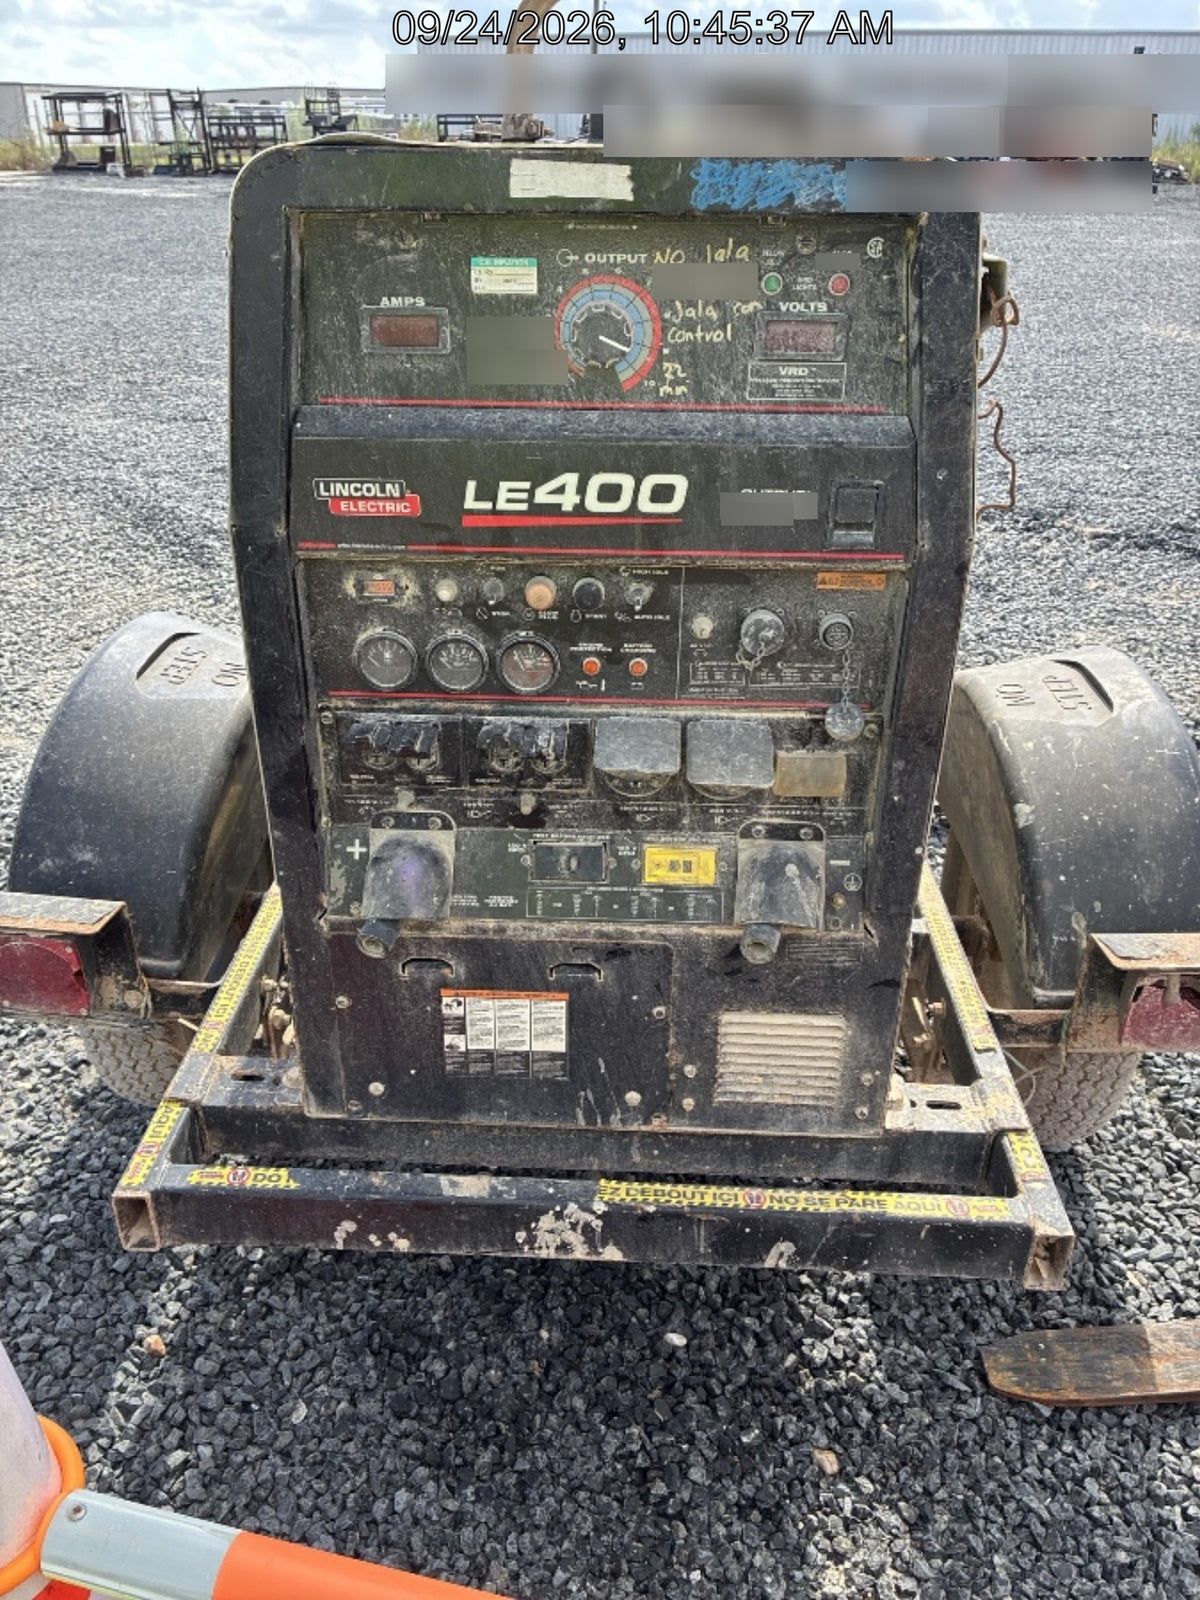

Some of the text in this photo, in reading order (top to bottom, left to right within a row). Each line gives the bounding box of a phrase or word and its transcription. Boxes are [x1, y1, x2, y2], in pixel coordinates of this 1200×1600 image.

[585, 252, 648, 265] OUTPUT
[379, 296, 426, 308] AMPS
[779, 301, 828, 312] VOLTS
[318, 481, 402, 498] LINCOLN
[463, 472, 690, 514] LE400
[340, 500, 412, 514] ELECTRIC
[160, 646, 208, 686] STEP
[211, 662, 247, 687] NO
[995, 682, 1035, 708] NO
[1041, 674, 1093, 711] STEP
[252, 1172, 282, 1183] DO
[625, 1187, 707, 1202] DEBOUT
[712, 1191, 740, 1203] ICI
[769, 1194, 799, 1206] NO
[804, 1196, 831, 1208] SE
[835, 1197, 888, 1210] PARE
